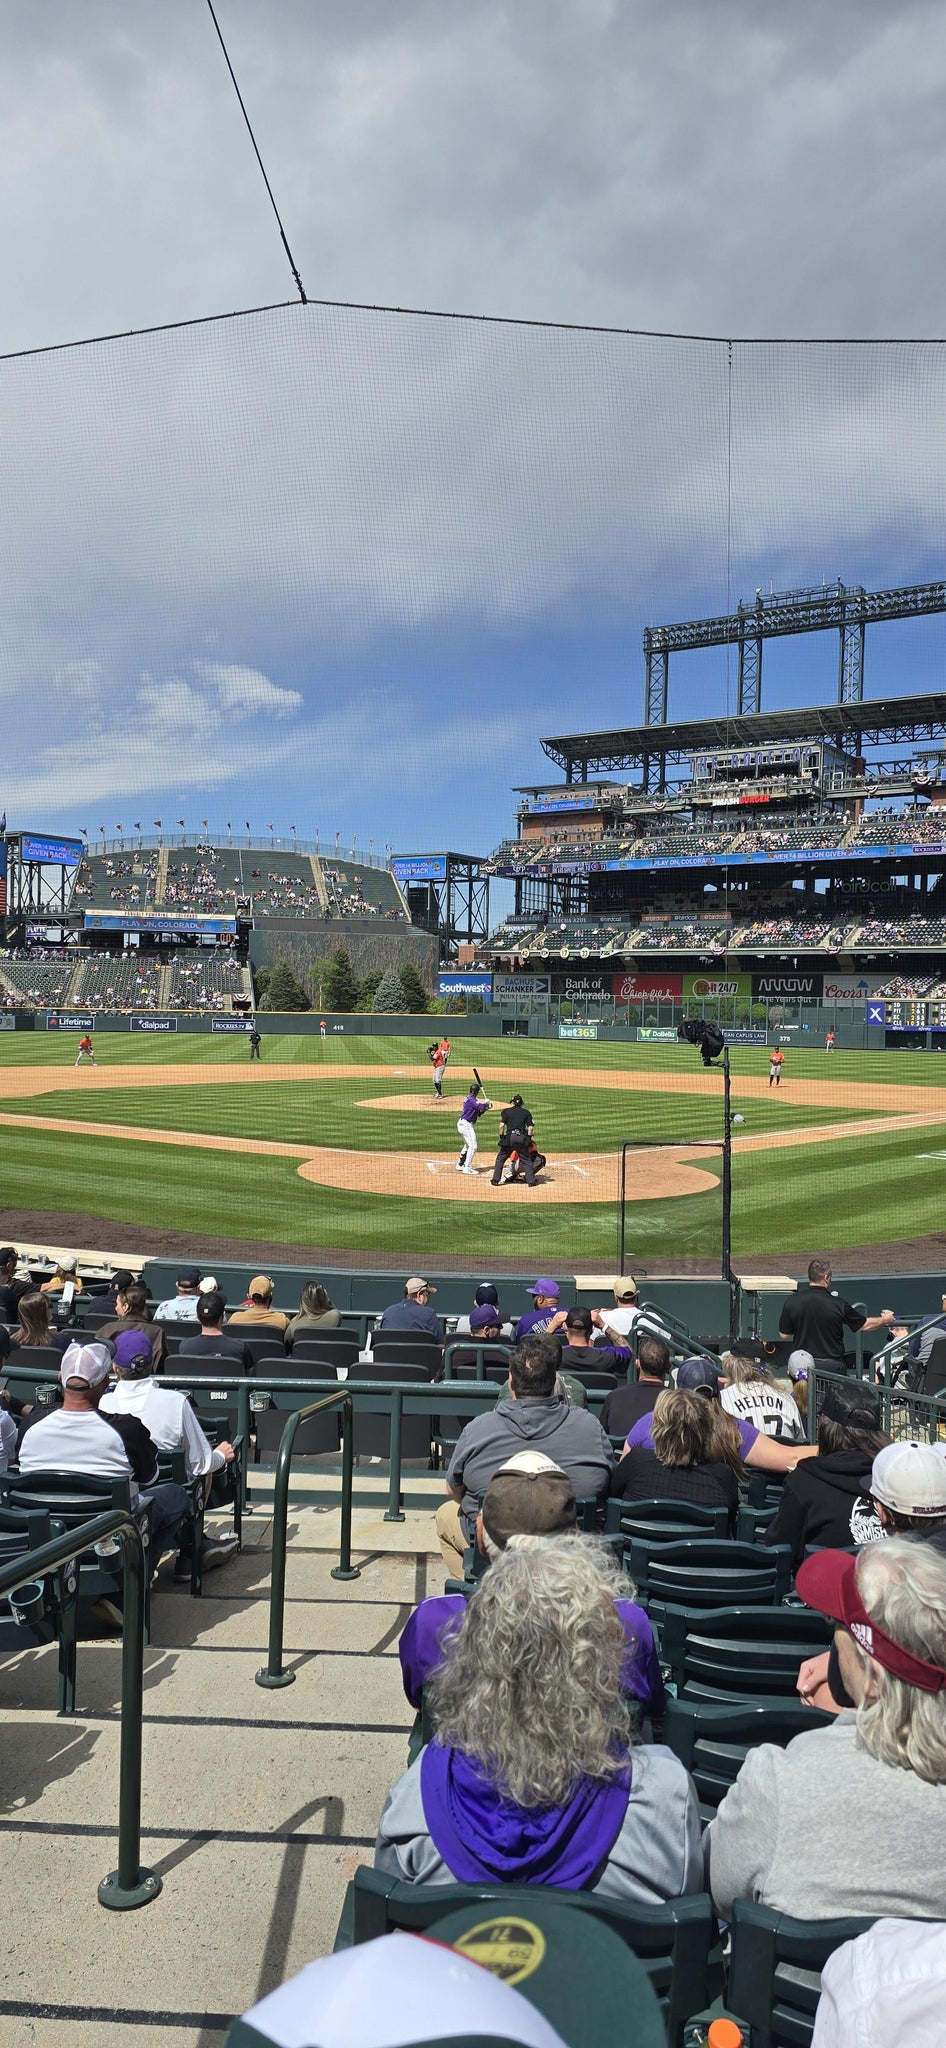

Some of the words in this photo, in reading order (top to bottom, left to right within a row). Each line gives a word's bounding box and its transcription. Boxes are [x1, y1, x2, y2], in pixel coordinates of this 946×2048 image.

[689, 754, 718, 773] THE
[730, 746, 813, 769] ROOFTOP
[28, 848, 49, 857] GIVEN
[798, 850, 824, 859] BILLION
[826, 849, 848, 858] GIVEN
[653, 858, 669, 866] PLAY
[439, 982, 486, 993] Southwest
[505, 978, 534, 986] BACHUS
[565, 978, 589, 989] Bank
[591, 977, 602, 989] of
[718, 982, 738, 993] 24/7
[758, 979, 813, 991] ARROW
[495, 985, 534, 993] SCHANKER
[565, 989, 611, 1000] Colorado
[825, 984, 864, 999] Coors
[58, 1017, 92, 1026] Lifetime
[141, 1021, 170, 1030] dialpad
[560, 1027, 596, 1038] bet365
[734, 1395, 783, 1413] HELTON
